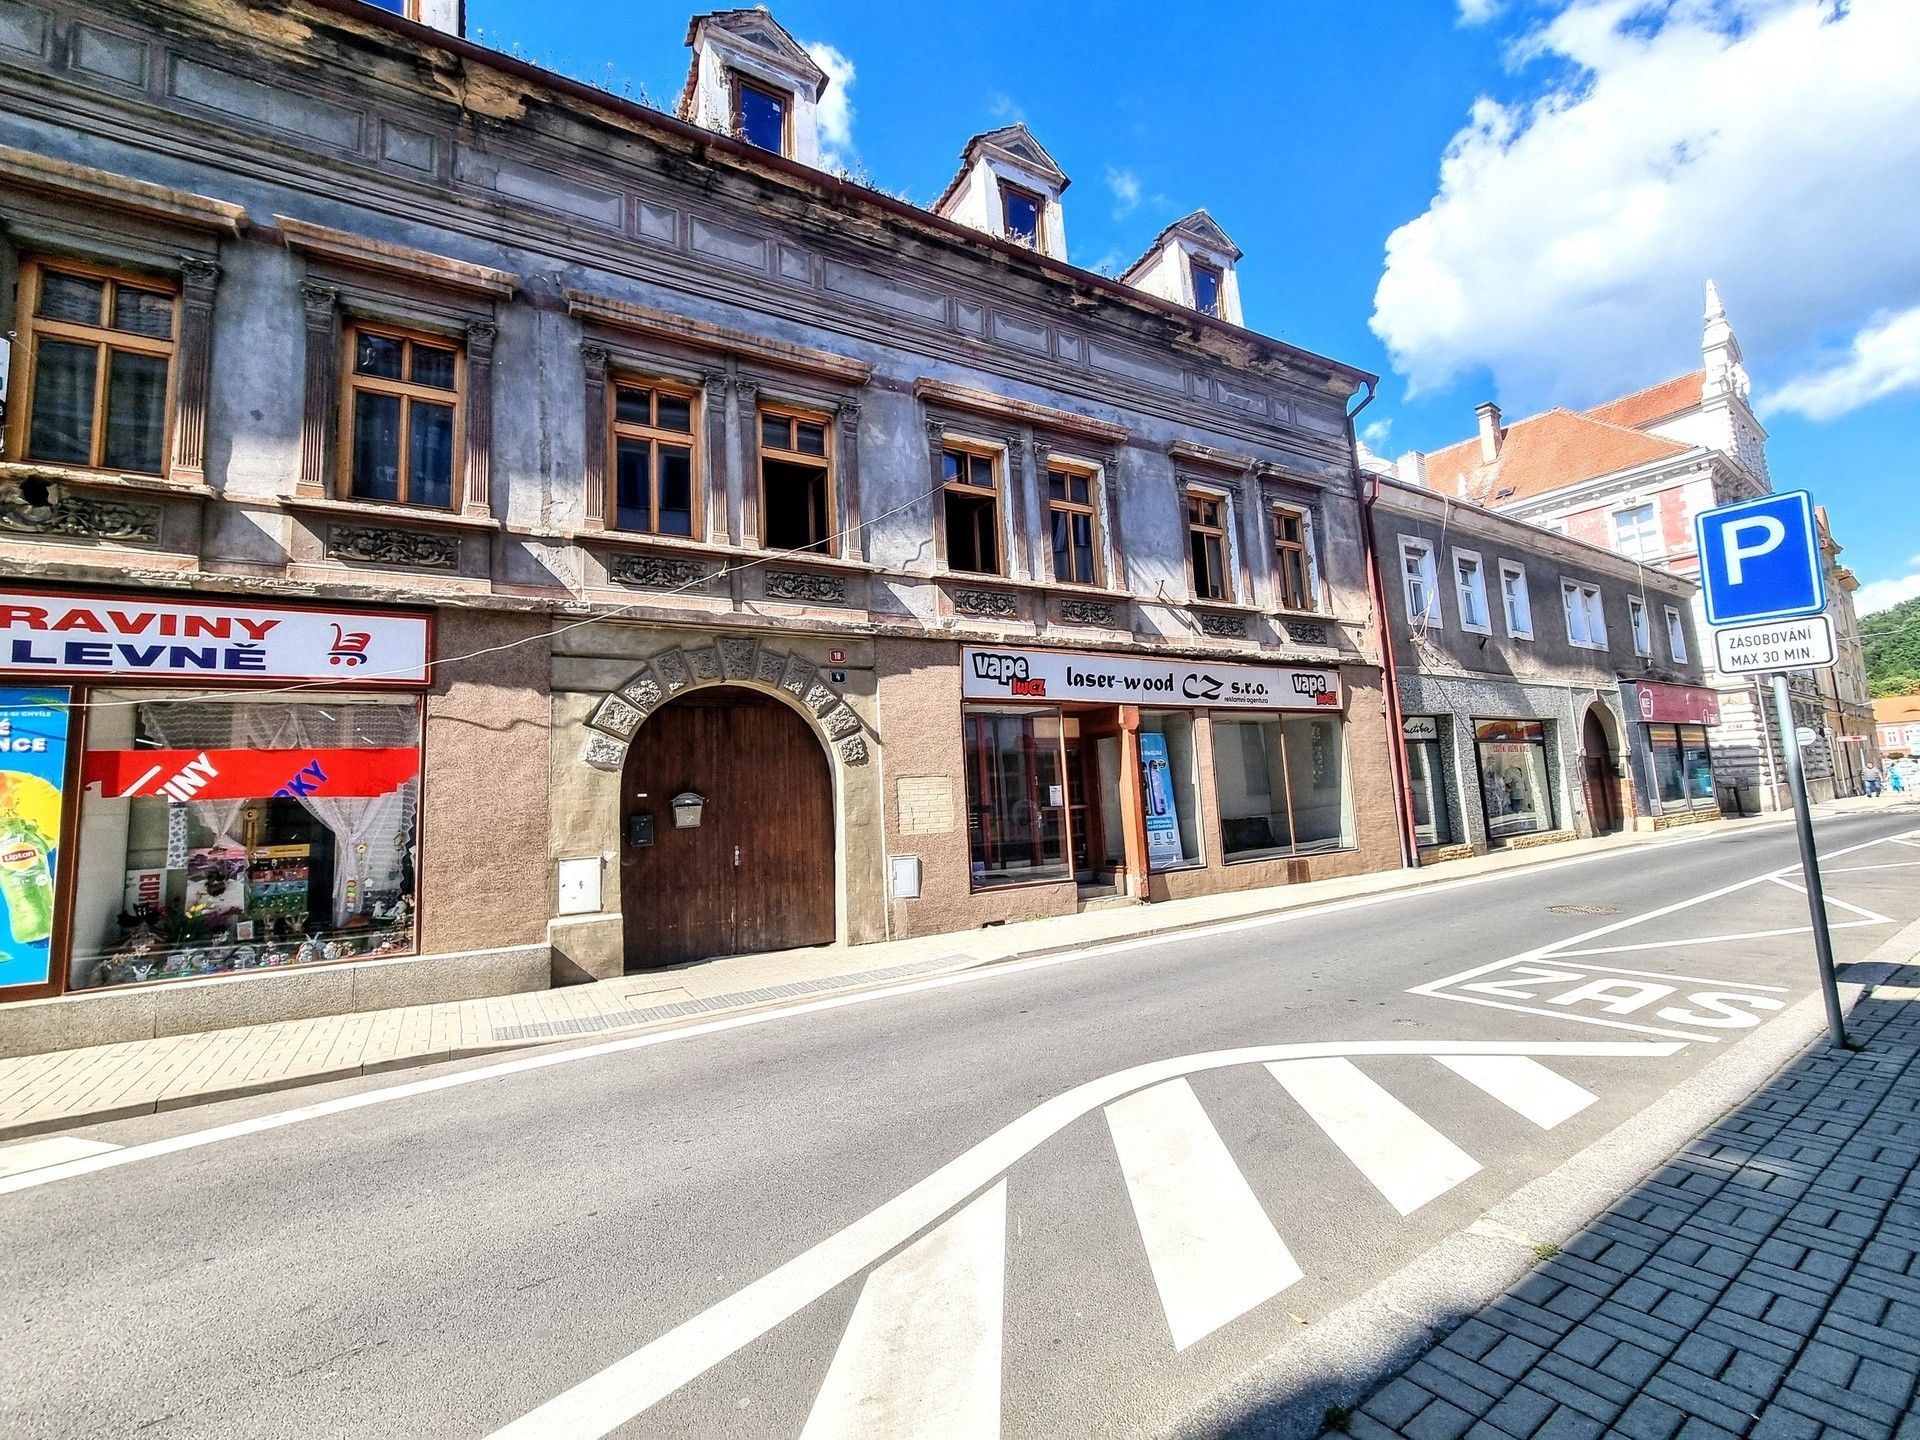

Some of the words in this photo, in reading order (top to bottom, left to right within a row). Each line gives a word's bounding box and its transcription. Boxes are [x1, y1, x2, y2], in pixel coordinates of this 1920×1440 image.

[1721, 515, 1786, 586] P
[0, 604, 282, 640] RAVINY
[1729, 625, 1812, 649] ZÁSOBOVÁNÍ
[11, 640, 266, 671] LEVNĚ
[973, 653, 1029, 685] vape
[1731, 653, 1759, 667] MAX
[1763, 650, 1779, 663] 30
[1784, 646, 1815, 660] MIN.
[1066, 666, 1174, 692] laser-wood
[1182, 673, 1225, 700] CZ
[1231, 680, 1269, 695] s.r.o.
[1292, 673, 1326, 698] vape
[155, 752, 220, 803] INY
